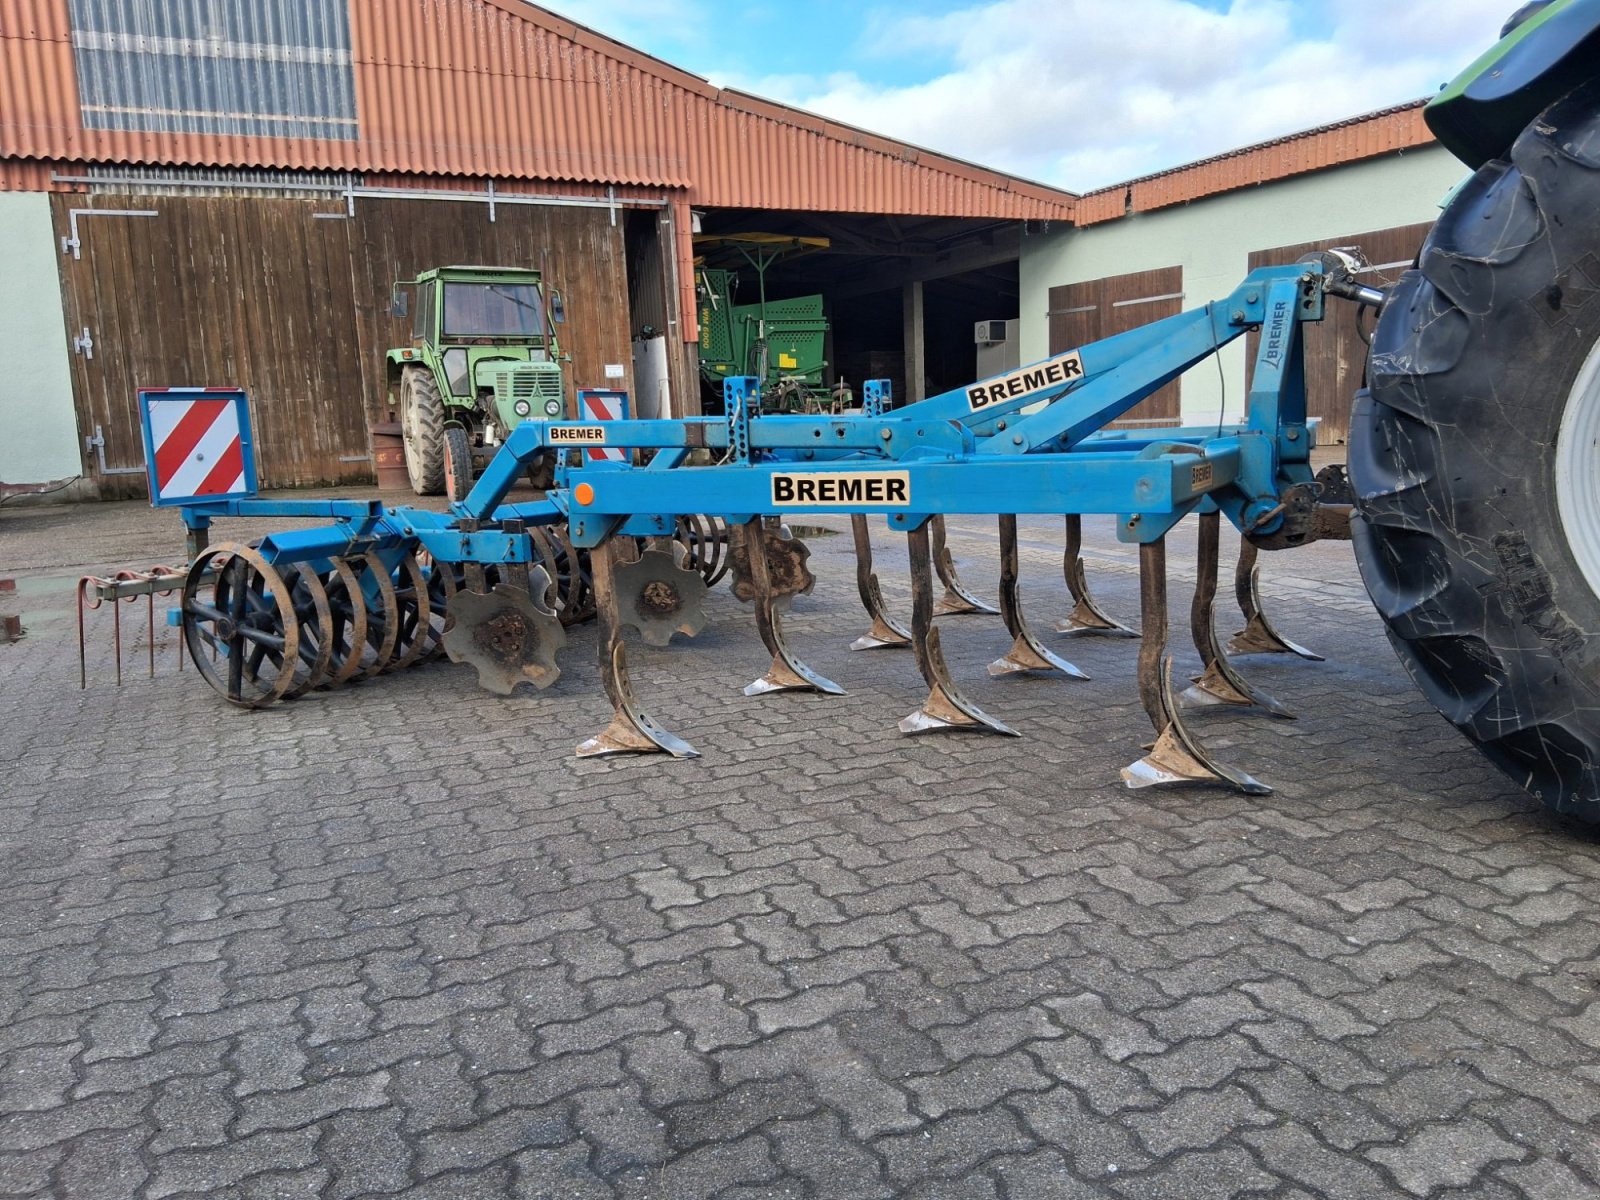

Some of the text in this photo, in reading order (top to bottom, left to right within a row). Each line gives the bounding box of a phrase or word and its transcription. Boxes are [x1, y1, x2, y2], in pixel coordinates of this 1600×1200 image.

[703, 308, 709, 325] WM
[1266, 301, 1286, 359] BREMER
[968, 358, 1082, 410] BREMER
[550, 428, 603, 439] BREMER
[1192, 465, 1211, 484] BREMER
[773, 476, 907, 501] BREMER
